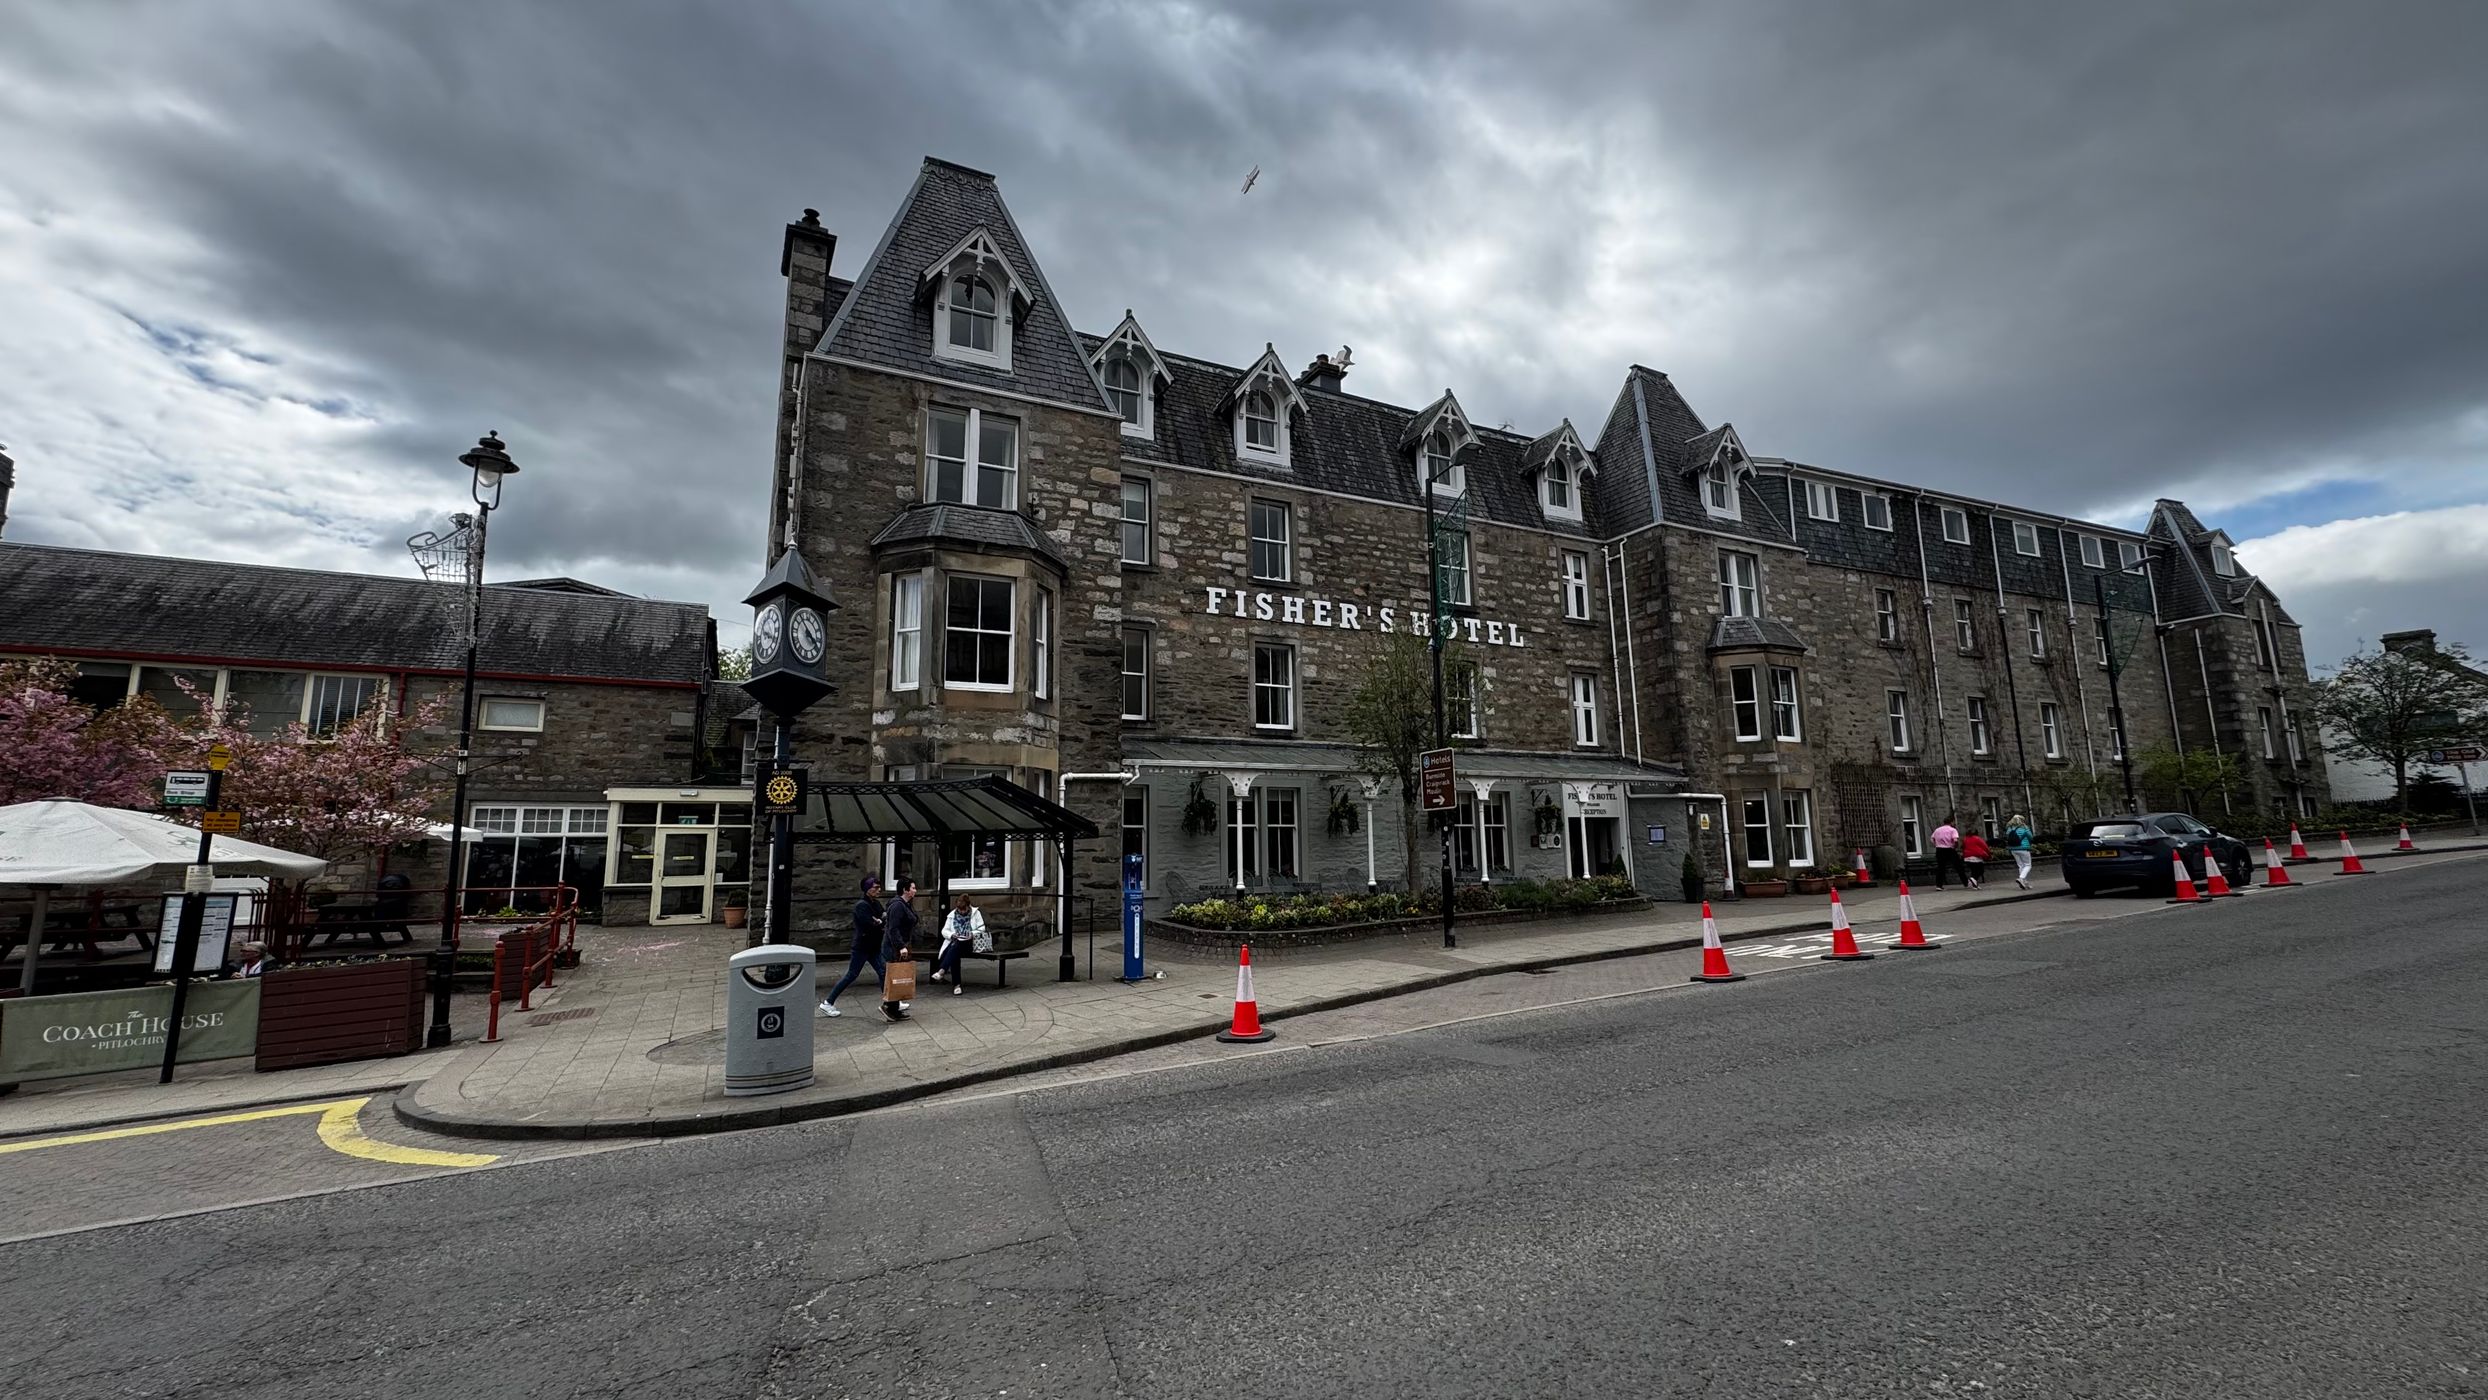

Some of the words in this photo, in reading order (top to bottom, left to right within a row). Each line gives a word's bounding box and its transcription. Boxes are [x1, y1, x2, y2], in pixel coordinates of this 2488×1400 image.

[1205, 586, 1395, 634] FISHER'S
[1409, 611, 1525, 648] HOTEL
[1430, 755, 1451, 766] Hotels
[127, 1010, 145, 1020] The
[42, 1021, 132, 1043] COACH
[98, 1035, 165, 1050] PITLOCHRY
